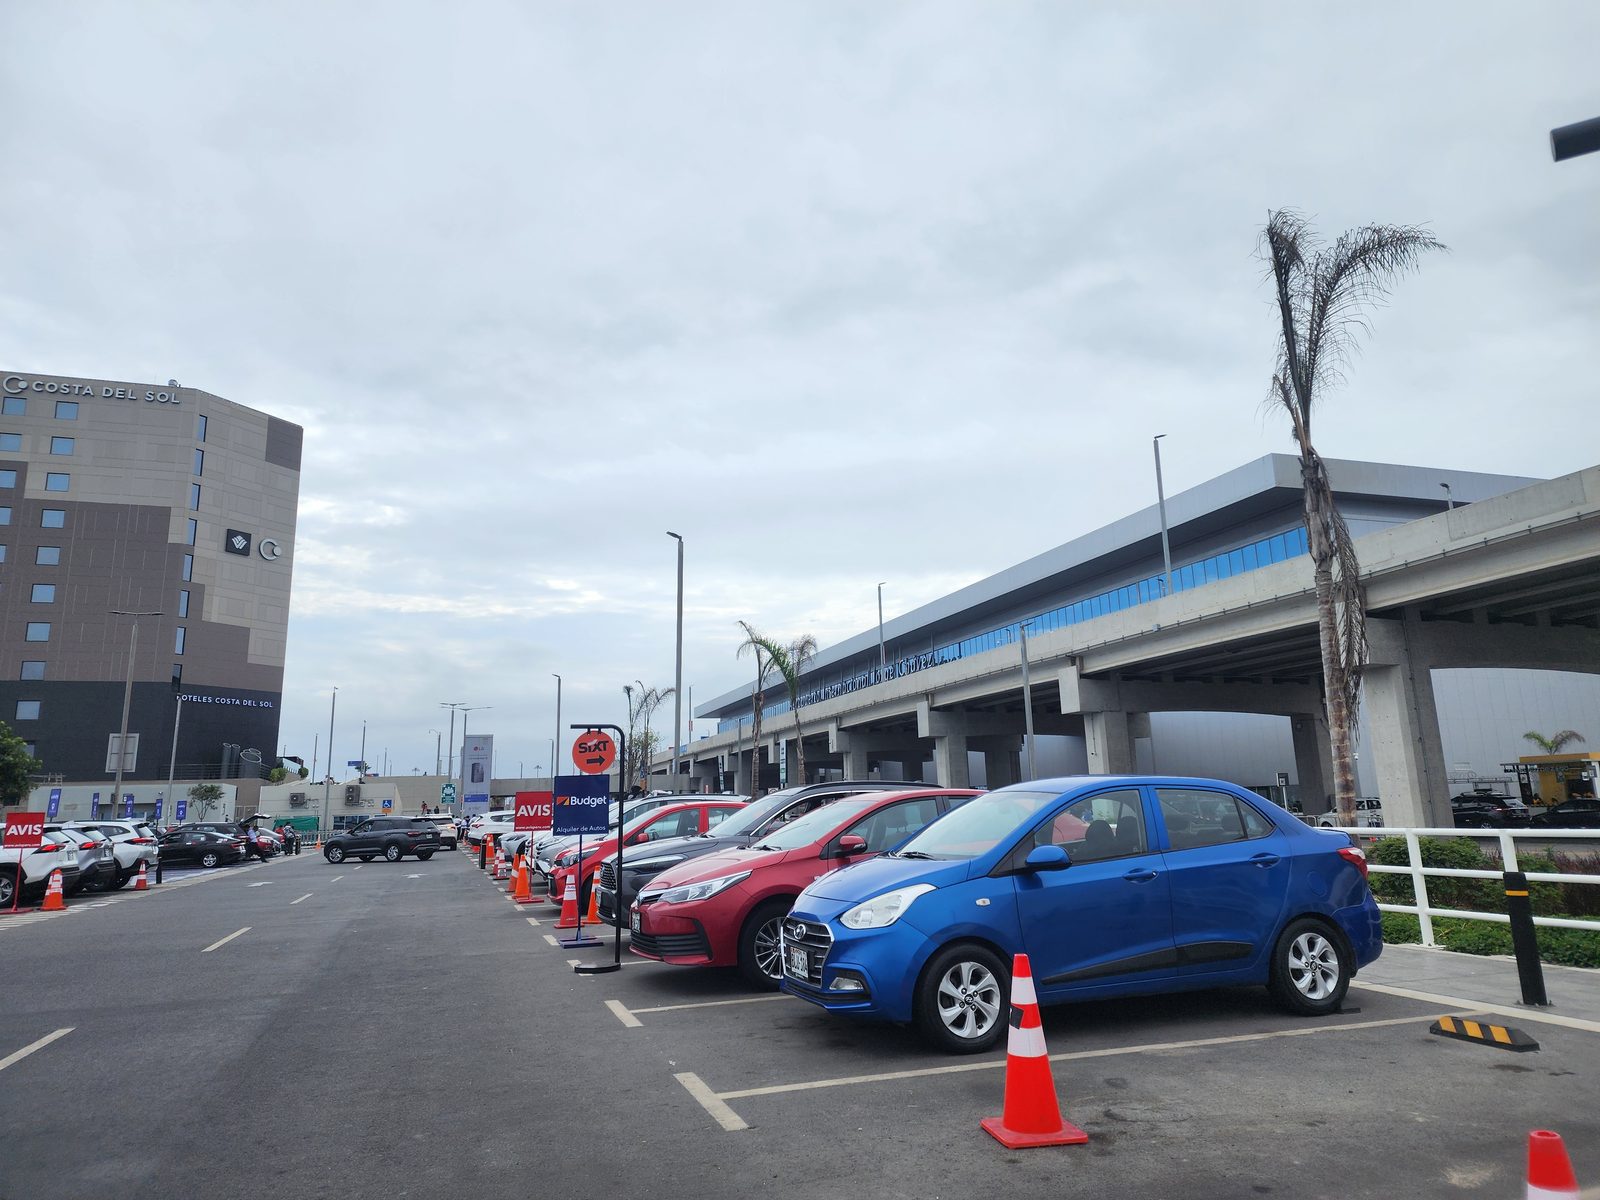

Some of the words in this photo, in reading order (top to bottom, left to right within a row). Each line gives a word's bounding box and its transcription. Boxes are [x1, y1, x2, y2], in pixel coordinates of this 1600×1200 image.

[32, 381, 94, 397] COSTA
[102, 386, 137, 400] DEL
[145, 391, 180, 404] SOL
[215, 697, 240, 705] COSTA
[242, 699, 257, 707] DEL
[570, 796, 607, 808] Budget
[517, 804, 551, 817] AVIS
[6, 824, 42, 836] AVIS
